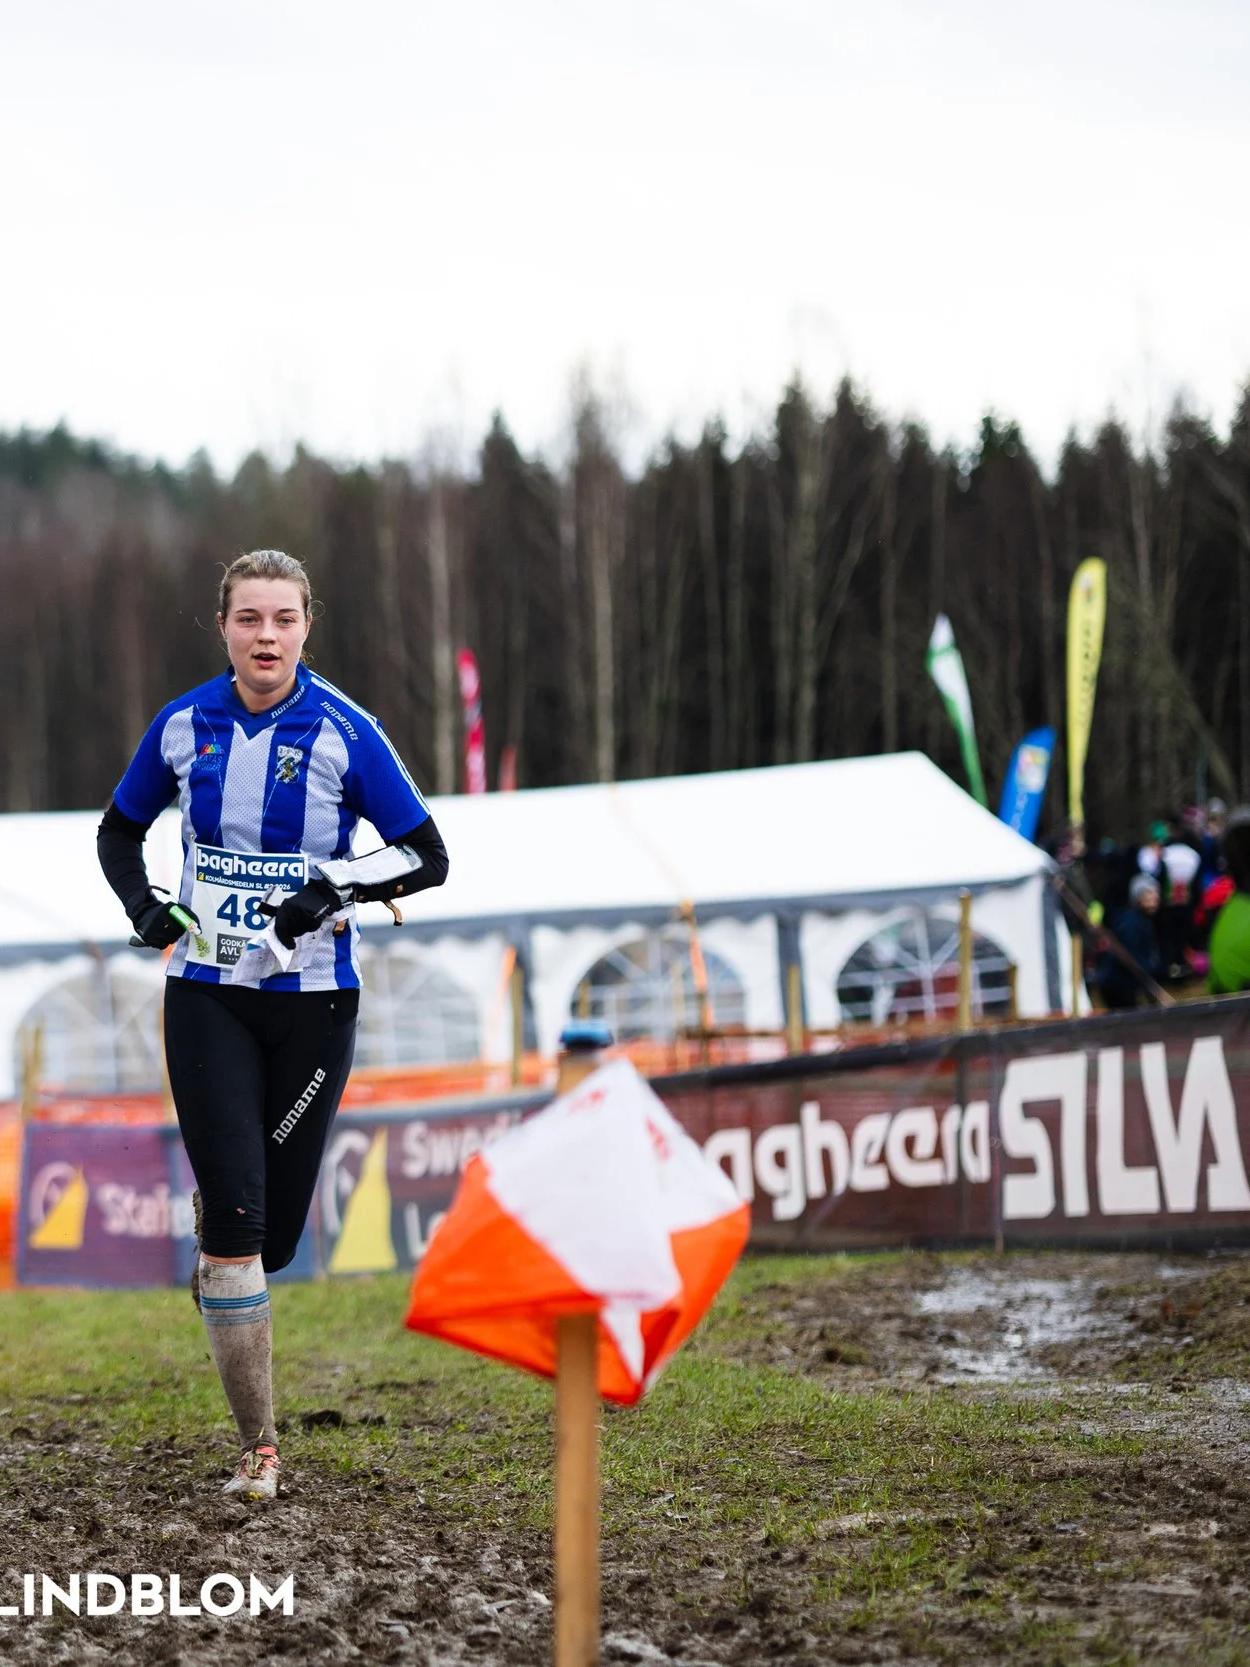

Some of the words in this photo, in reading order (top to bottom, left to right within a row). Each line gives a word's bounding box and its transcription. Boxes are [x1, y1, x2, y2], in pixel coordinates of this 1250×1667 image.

[271, 685, 305, 719] noname
[320, 701, 358, 741] noname
[197, 849, 304, 877] bagheera
[217, 893, 269, 931] 48
[272, 1068, 326, 1145] noname
[1000, 1034, 1250, 1220] SILVA
[700, 1100, 991, 1222] agheera
